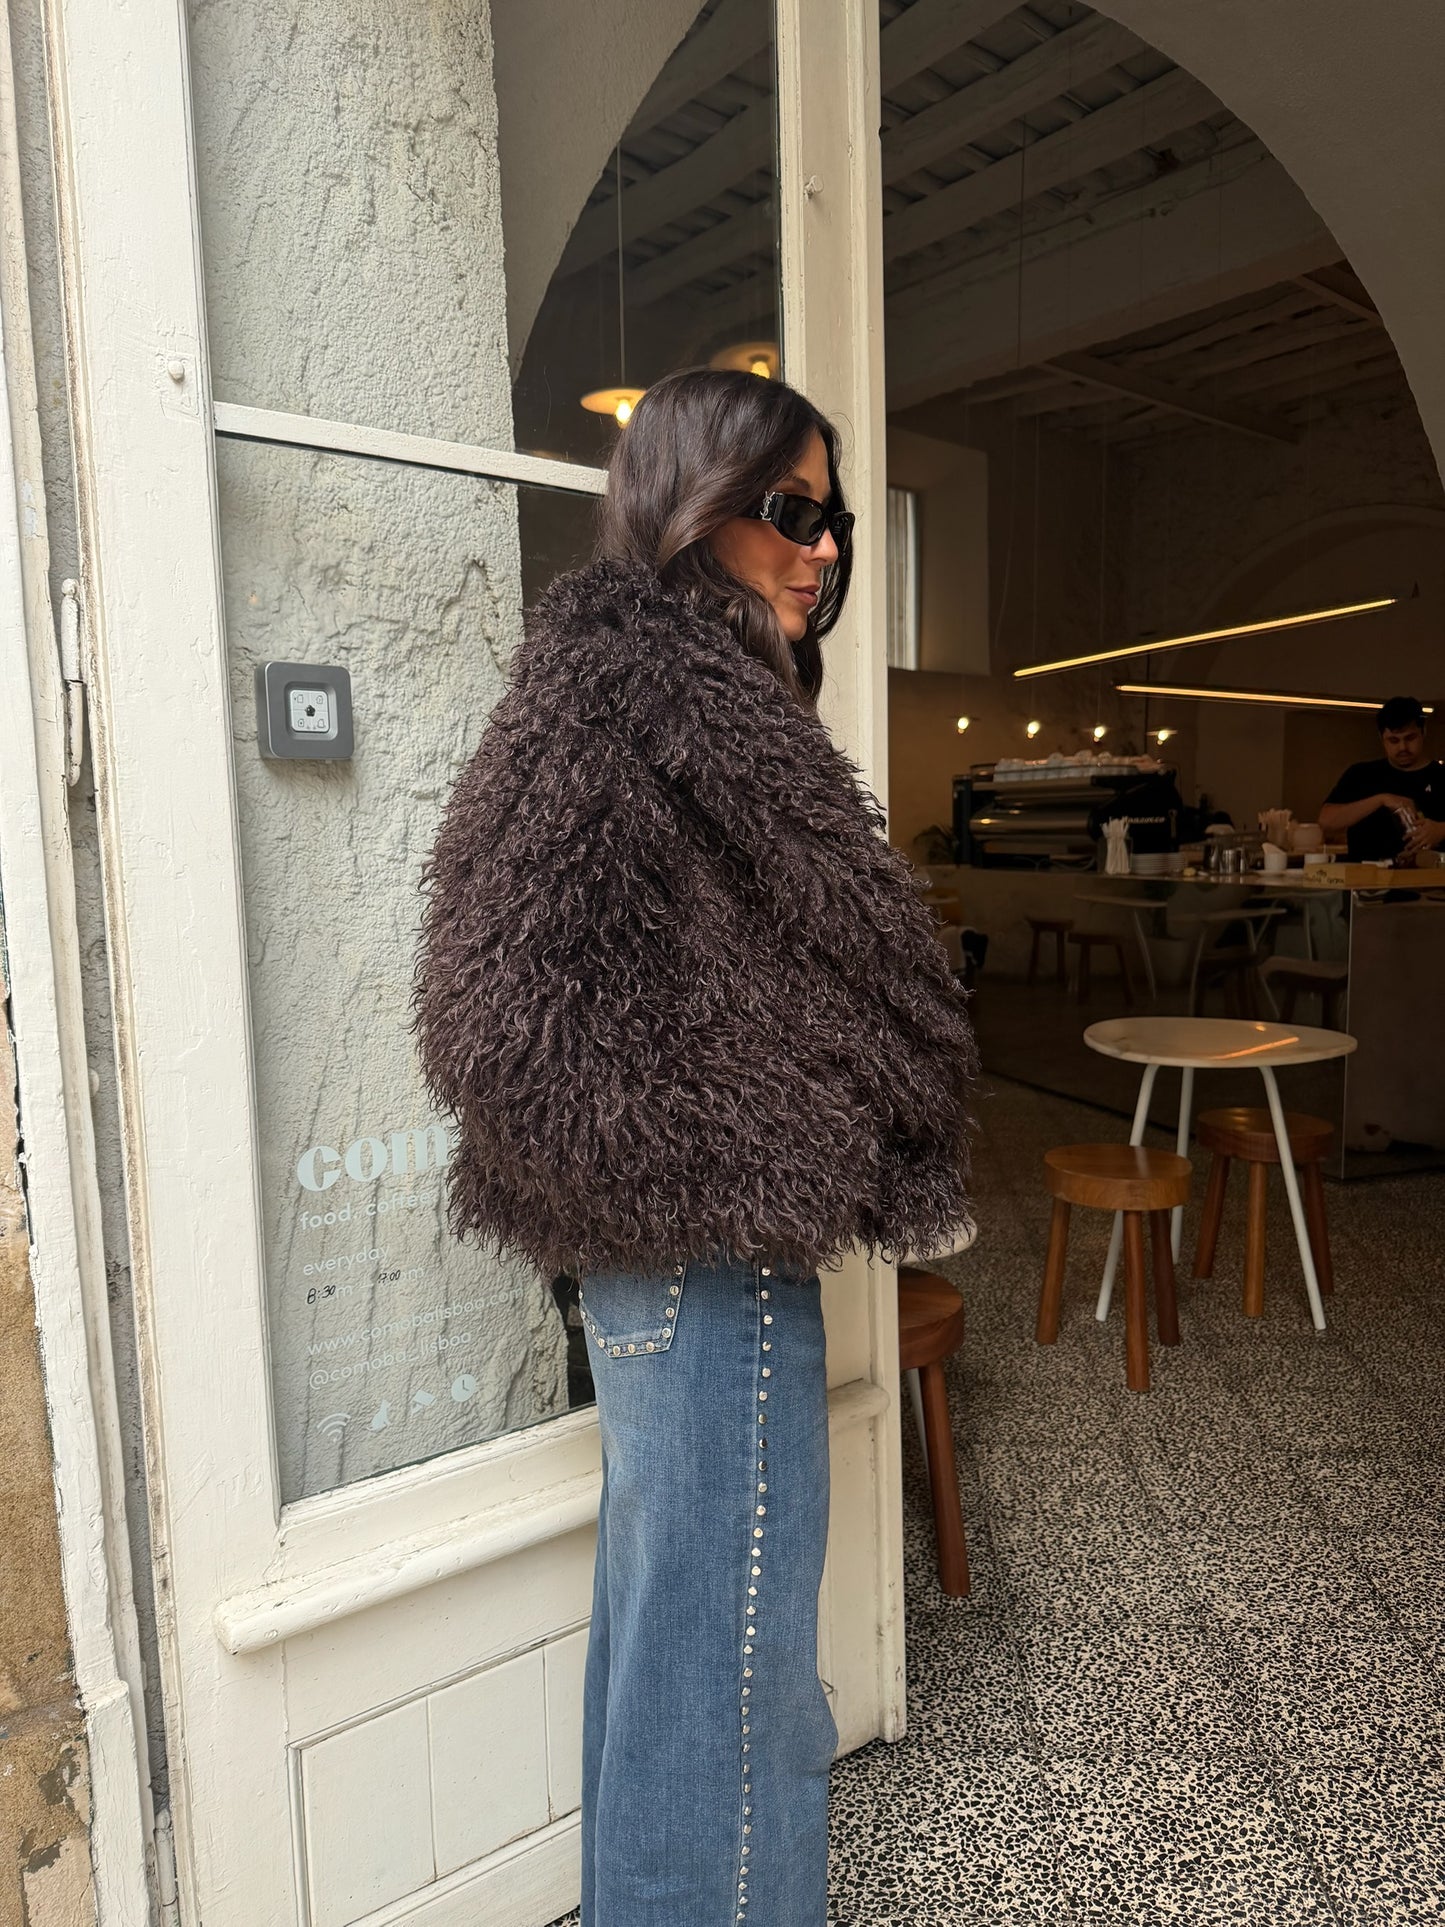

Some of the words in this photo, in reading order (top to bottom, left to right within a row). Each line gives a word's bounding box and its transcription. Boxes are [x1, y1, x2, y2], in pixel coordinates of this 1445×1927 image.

[297, 1125, 461, 1193] com
[366, 1191, 431, 1217] coffee
[302, 1245, 391, 1277] everyday
[306, 1284, 337, 1305] 8:30
